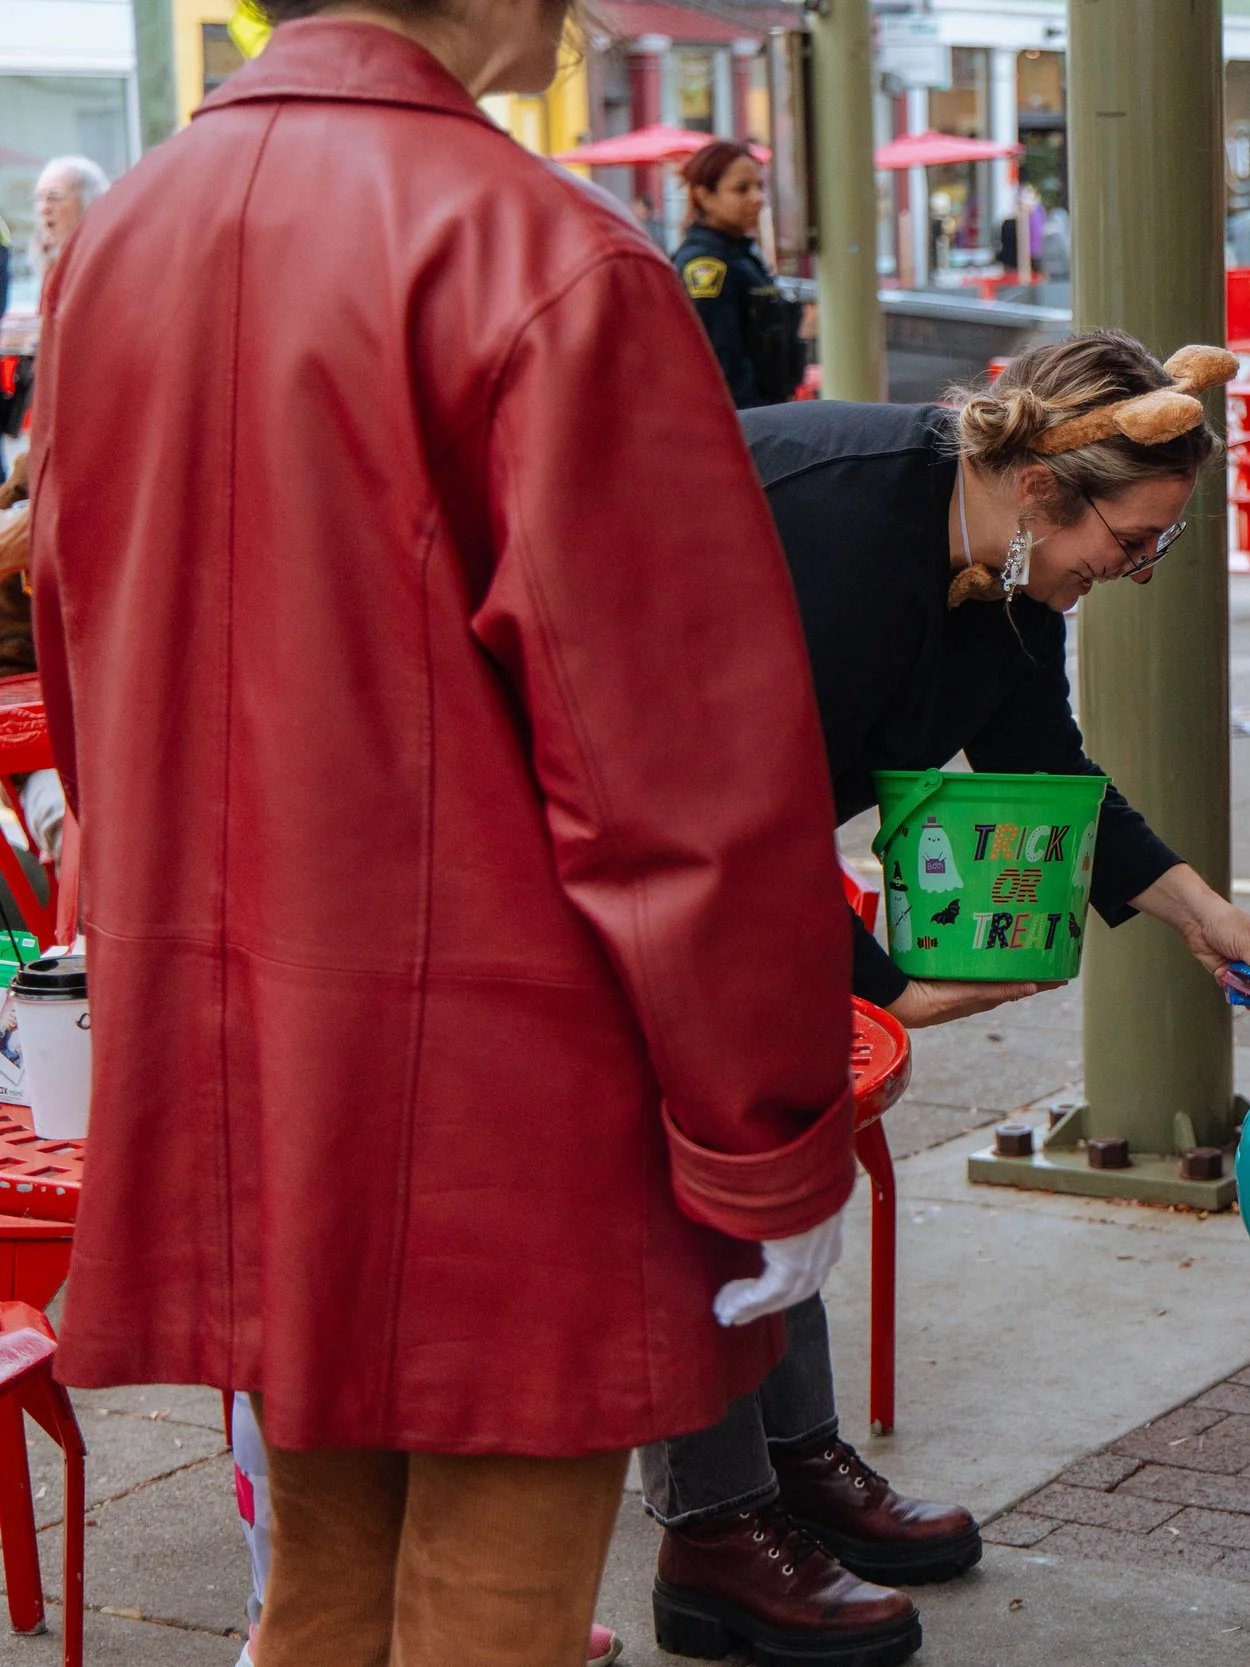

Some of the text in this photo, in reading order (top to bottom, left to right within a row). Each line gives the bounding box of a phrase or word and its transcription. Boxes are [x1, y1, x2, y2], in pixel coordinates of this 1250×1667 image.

[974, 824, 1071, 862] TRICK
[992, 867, 1042, 904] OR
[972, 912, 1062, 950] TREAT
